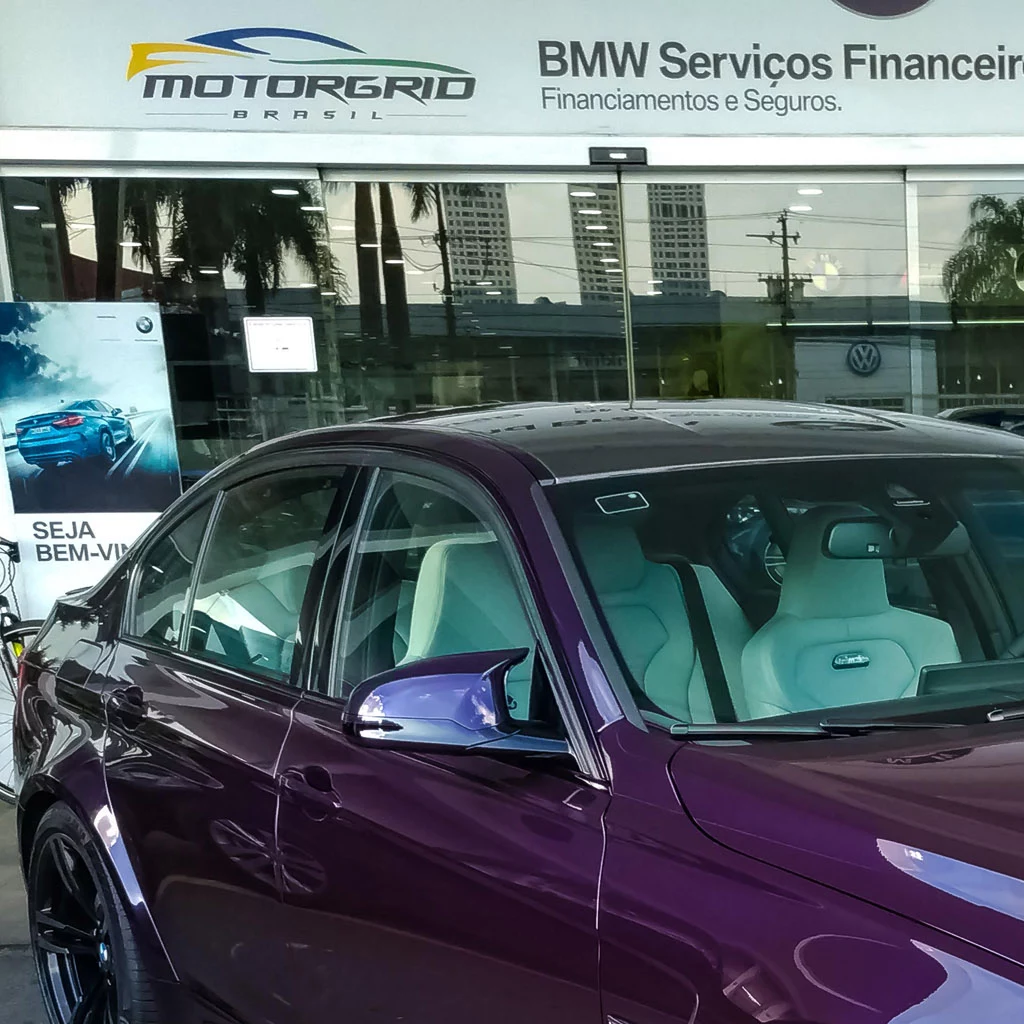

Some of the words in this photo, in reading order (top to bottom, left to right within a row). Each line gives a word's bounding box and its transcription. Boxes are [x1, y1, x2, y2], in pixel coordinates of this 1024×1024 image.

[538, 40, 650, 78] BMW
[659, 41, 833, 88] Serviços
[143, 74, 477, 106] MOTORGRID
[541, 86, 720, 112] Financiamentos
[724, 94, 739, 112] e
[743, 88, 842, 117] Seguros.
[232, 109, 384, 121] BRASIL
[32, 520, 96, 540] SEJA
